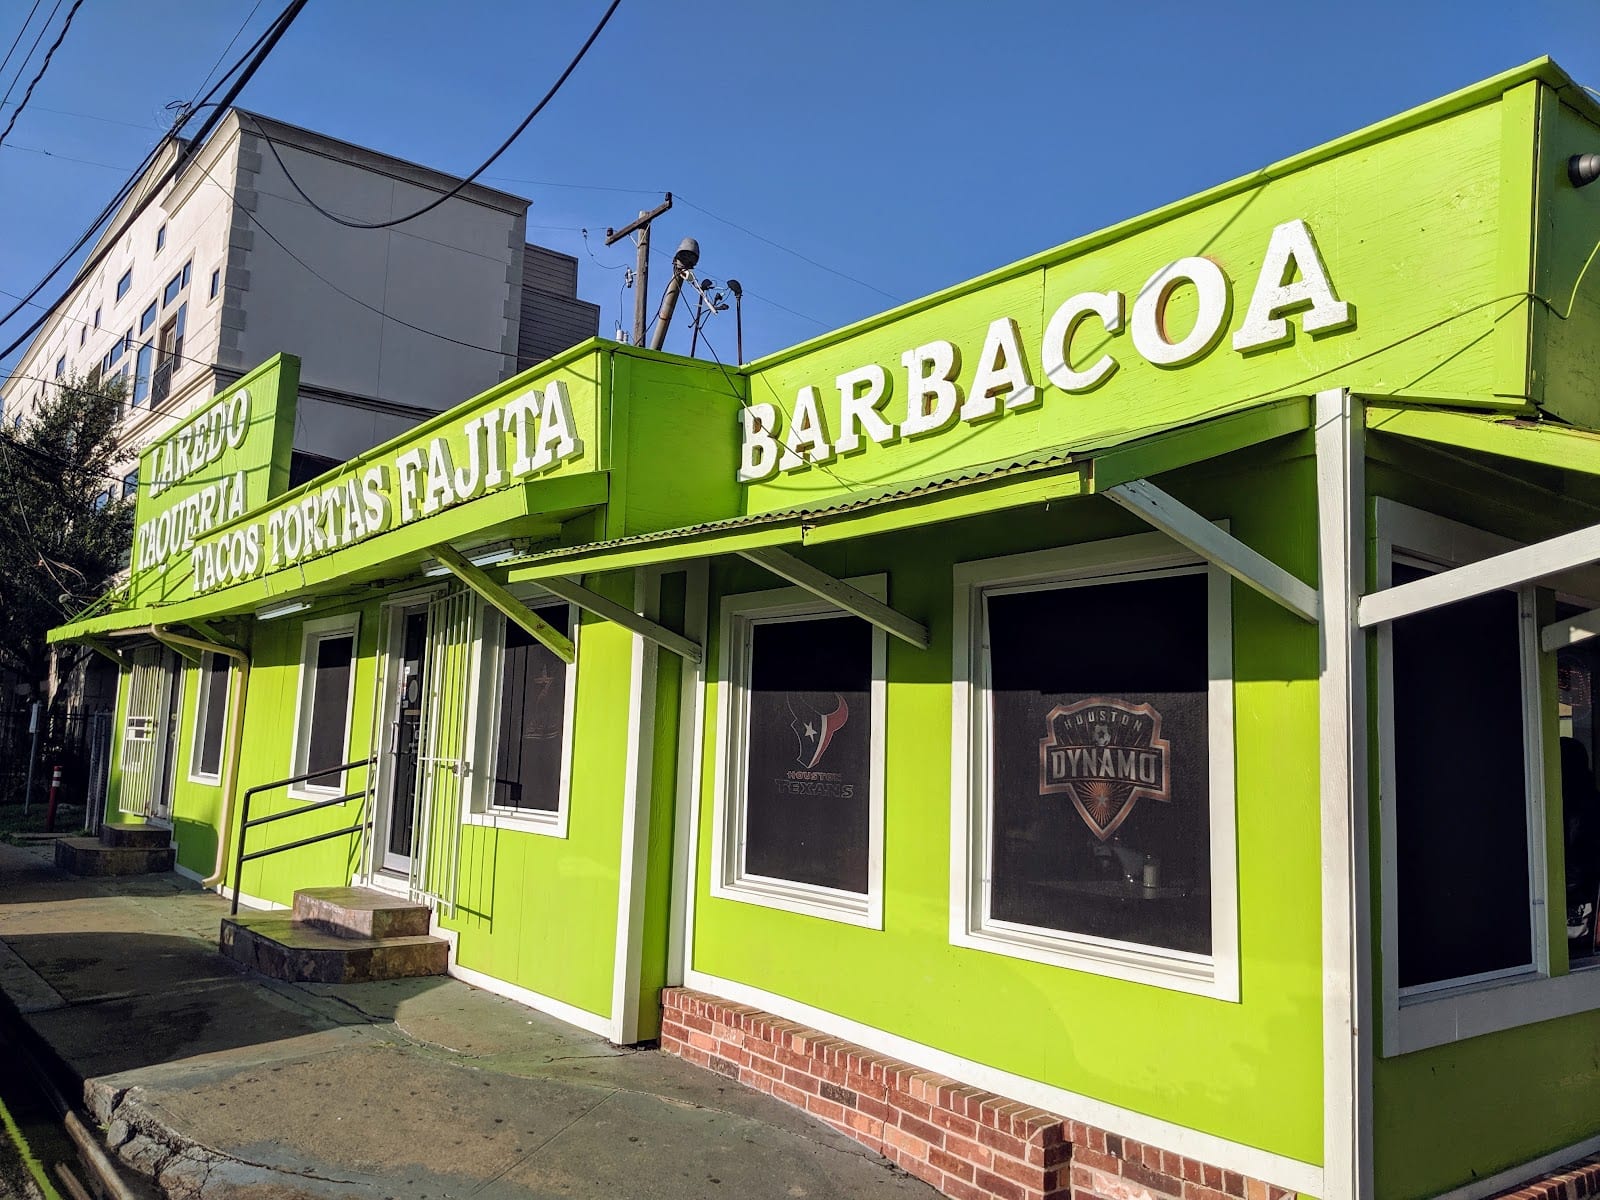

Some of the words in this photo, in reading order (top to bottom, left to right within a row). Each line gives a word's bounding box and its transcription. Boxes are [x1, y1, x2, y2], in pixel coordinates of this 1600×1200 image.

[736, 218, 1356, 484] BARBACOA
[149, 388, 252, 499] LAREDO
[191, 524, 264, 593] TACOS
[268, 465, 391, 566] TORTAS
[396, 379, 584, 524] FAJITA
[136, 470, 246, 575] TAQUERIA
[1063, 710, 1142, 732] HOUSTON
[774, 778, 854, 799] TEXANS
[786, 770, 843, 781] HOUSTON
[1050, 748, 1157, 784] DYNAMO
